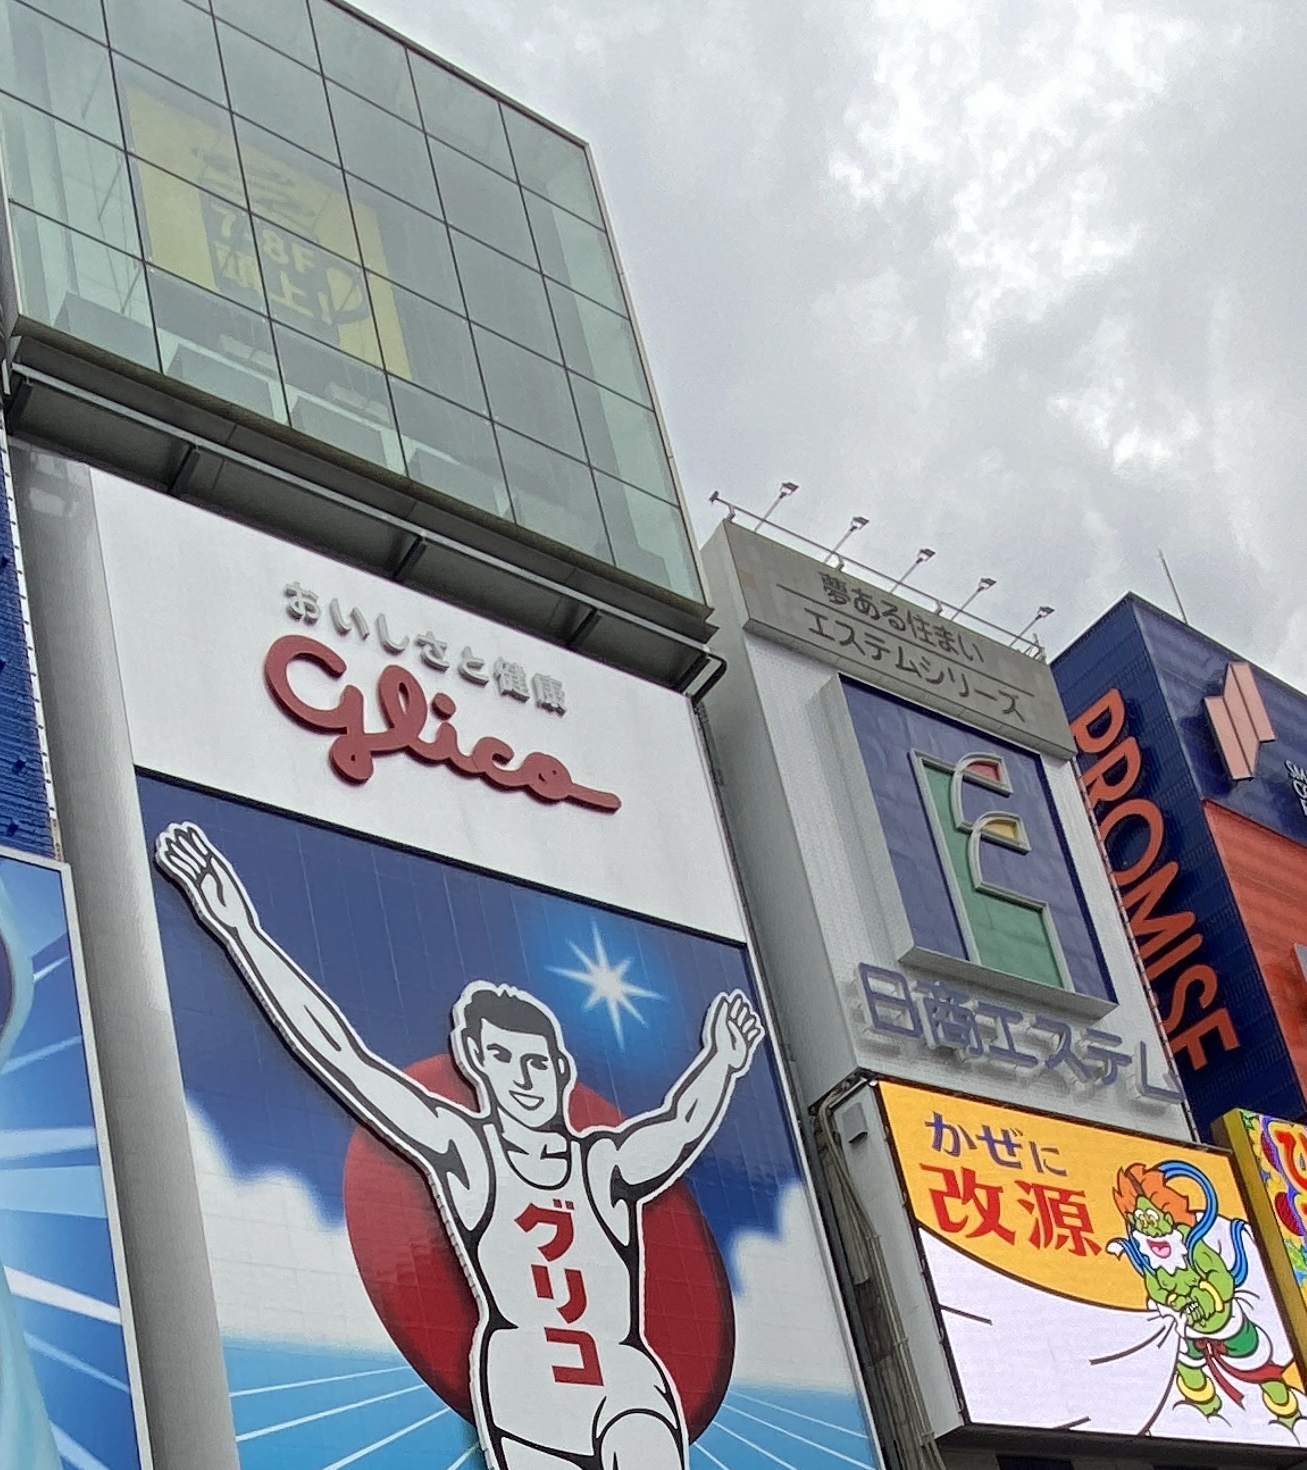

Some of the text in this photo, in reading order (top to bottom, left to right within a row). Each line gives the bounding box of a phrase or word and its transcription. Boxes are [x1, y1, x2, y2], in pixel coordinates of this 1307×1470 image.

[284, 578, 568, 717] おいしさと健康
[805, 606, 1027, 723] エステムシリーズ
[820, 570, 985, 665] 夢ある住まい
[1070, 687, 1242, 1072] PROMISE
[924, 1110, 1065, 1176] かぜに
[918, 1163, 1106, 1258] 改源
[513, 1196, 607, 1389] グリコ
